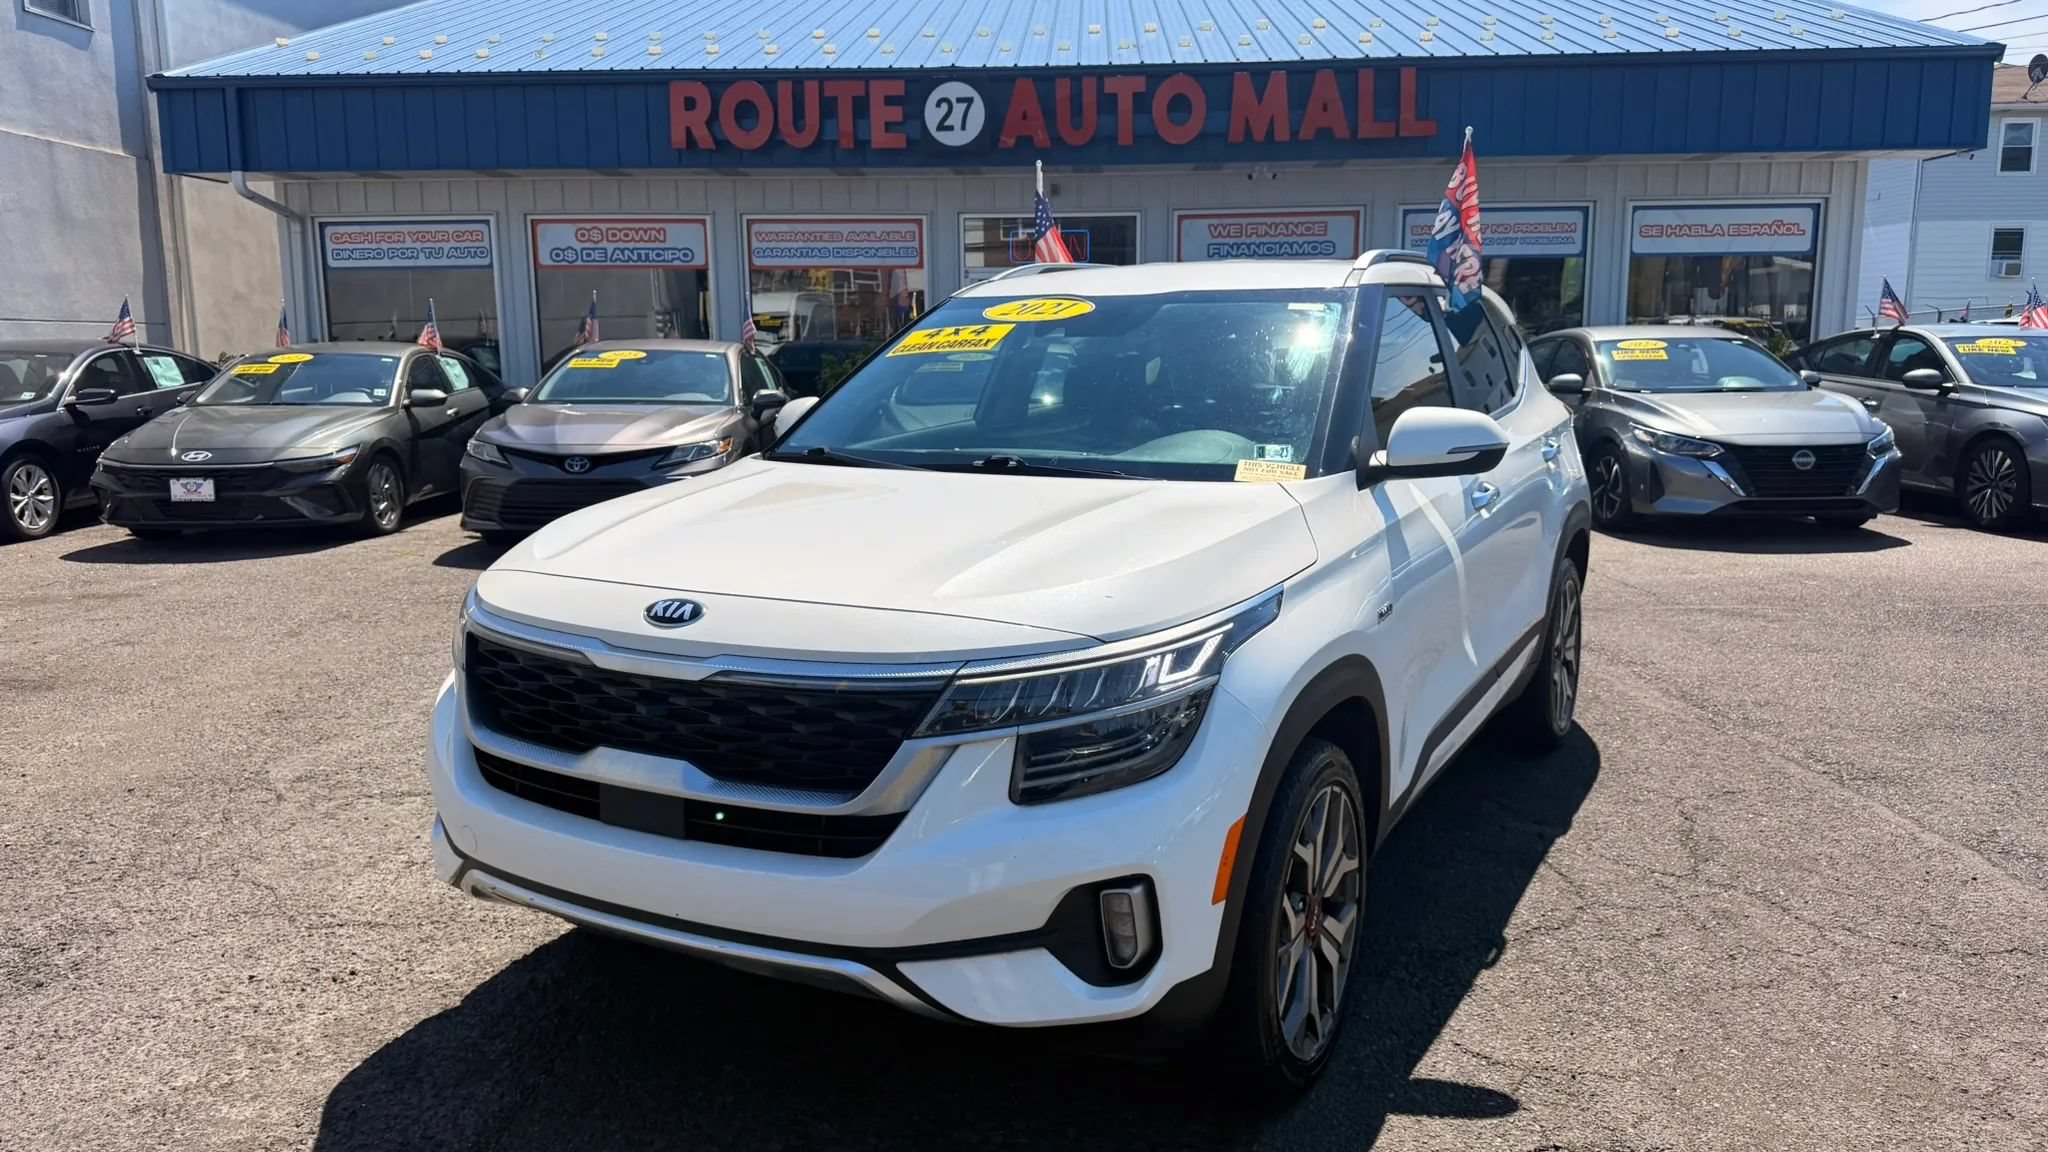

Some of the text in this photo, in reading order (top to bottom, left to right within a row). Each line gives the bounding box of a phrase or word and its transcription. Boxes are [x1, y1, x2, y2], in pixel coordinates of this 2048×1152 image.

[669, 66, 1437, 150] ROUTE 27 AUTO MALL
[606, 228, 666, 243] DOWN
[1208, 221, 1328, 238] WE FINANCE
[1491, 224, 1511, 234] NO
[1513, 223, 1576, 233] PROBLEM
[1639, 220, 1806, 237] SE HABLA ESPAÑOL
[330, 230, 484, 244] CASH FOR YOUR CAR
[755, 231, 917, 243] WARRANTIES AVAILABLE
[1519, 236, 1576, 245] PROBLEMA
[332, 246, 488, 261] DINERO POR TU AUTO
[581, 248, 608, 263] DE
[610, 248, 694, 263] ANTICIPO
[754, 247, 918, 259] GARANTIAS DISPONIBLES
[1013, 236, 1088, 260] ON
[1207, 240, 1335, 258] FINANCIAMOS
[1000, 302, 1078, 316] 2021
[891, 338, 998, 355] CLEAN CARFAX
[1266, 463, 1302, 471] VEHICLE
[650, 601, 695, 620] KIA
